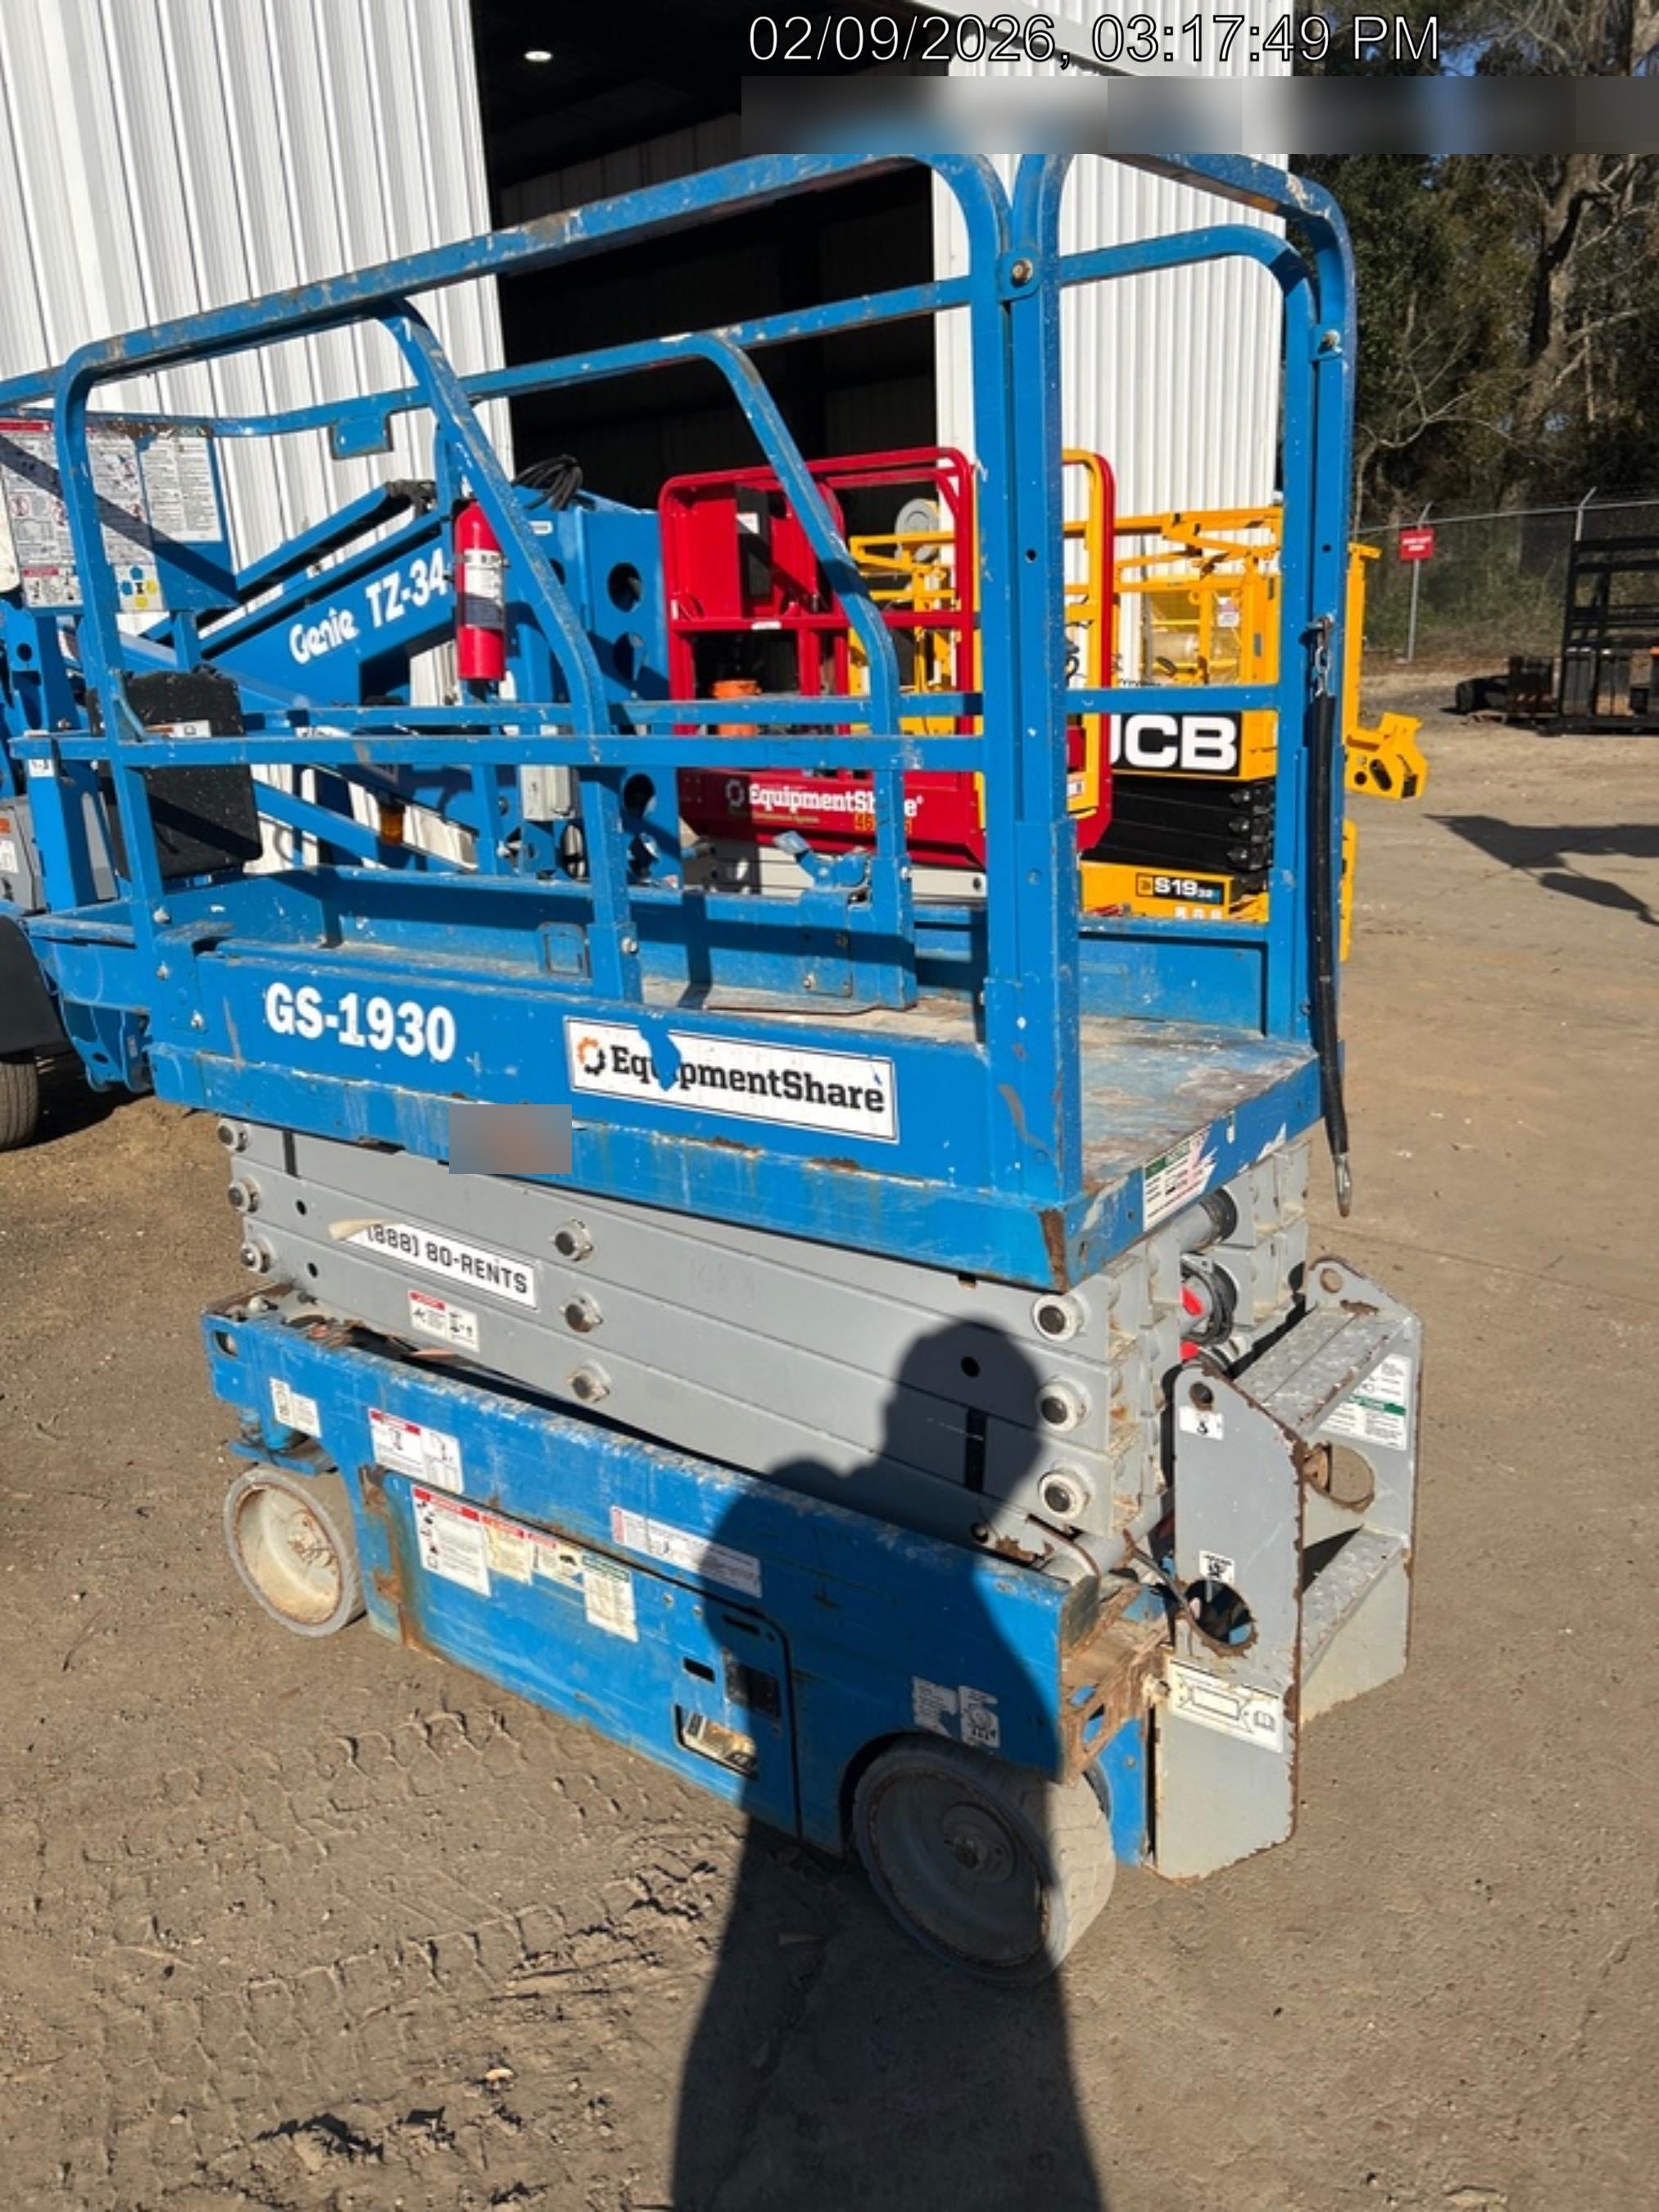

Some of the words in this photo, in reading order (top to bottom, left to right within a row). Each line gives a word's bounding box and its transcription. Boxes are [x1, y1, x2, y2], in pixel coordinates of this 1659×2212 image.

[289, 606, 360, 665] Genie
[365, 547, 448, 629] TZ-34
[749, 782, 918, 818] EquipmentSe
[265, 982, 456, 1063] GS-1930
[610, 1044, 886, 1113] EqpmentShare
